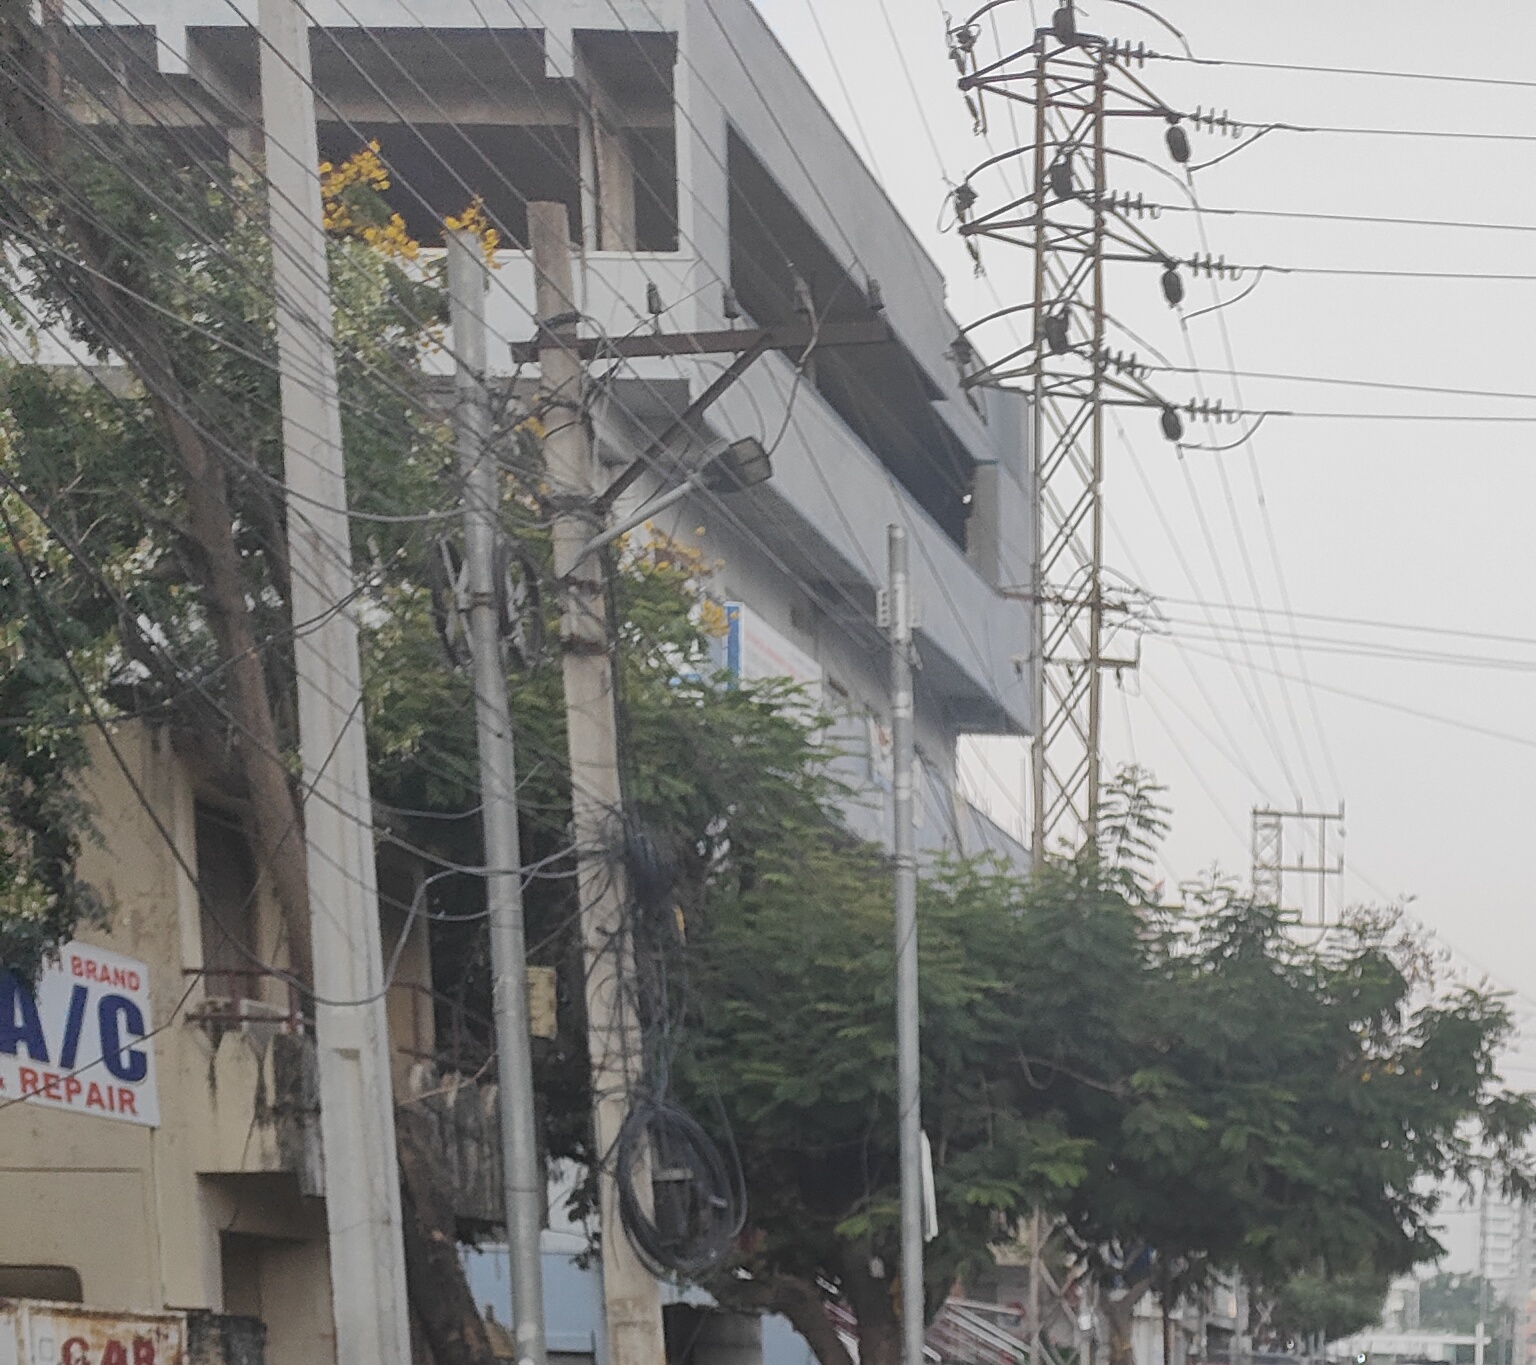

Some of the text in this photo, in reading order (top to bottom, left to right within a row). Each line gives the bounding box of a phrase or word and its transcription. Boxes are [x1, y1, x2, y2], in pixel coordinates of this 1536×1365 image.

[71, 955, 141, 992] BRAND
[0, 968, 148, 1082] A/C
[18, 1066, 138, 1117] REPAIR
